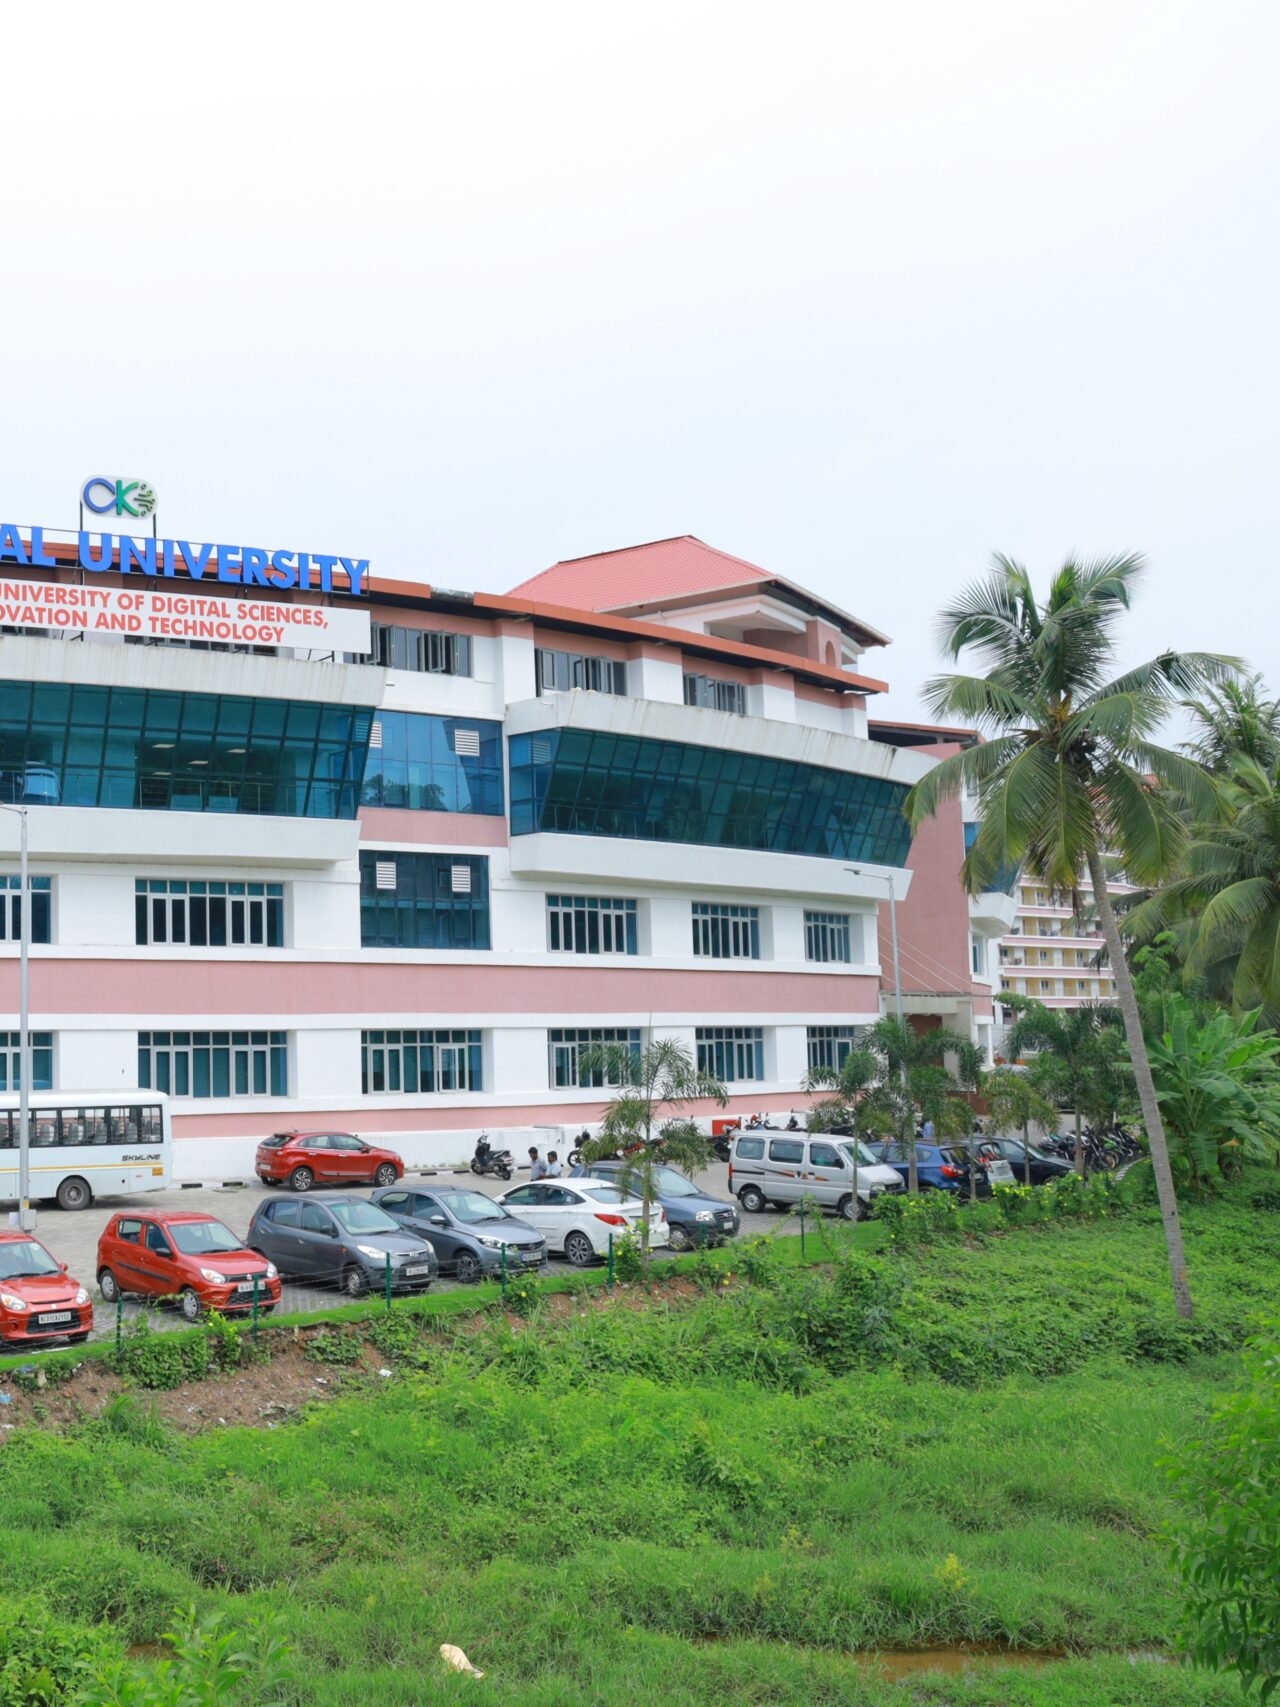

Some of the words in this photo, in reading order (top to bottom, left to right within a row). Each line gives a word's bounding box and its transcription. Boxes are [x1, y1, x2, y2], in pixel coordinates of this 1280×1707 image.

[78, 530, 370, 596] UNIVERSITY
[95, 612, 143, 632] AND
[148, 615, 286, 643] TECHNOLOGY
[117, 593, 145, 611] OF
[151, 595, 230, 619] DIGITAL
[237, 603, 329, 629] SCIENCES,
[121, 1153, 161, 1162] SKYLINE
